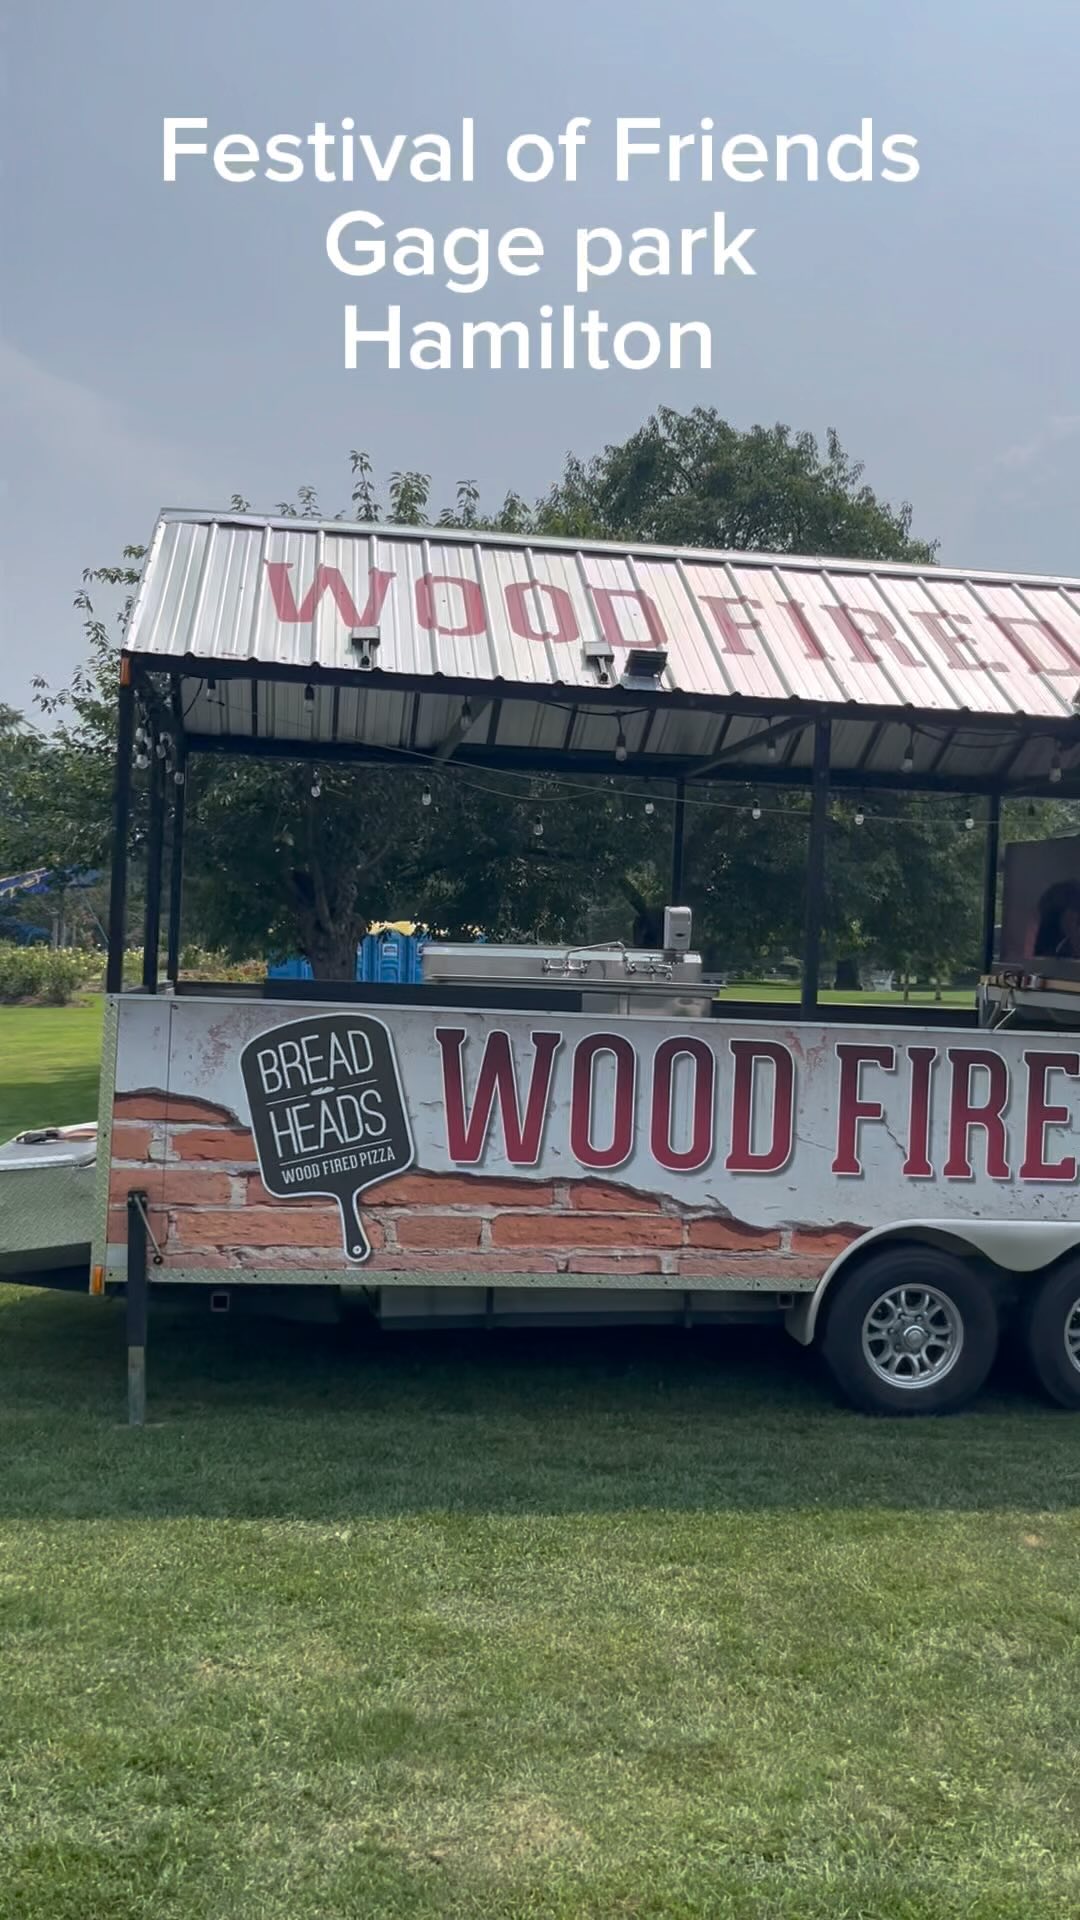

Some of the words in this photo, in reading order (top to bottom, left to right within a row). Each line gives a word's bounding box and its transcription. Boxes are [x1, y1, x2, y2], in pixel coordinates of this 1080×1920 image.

[263, 559, 668, 648] WOOD
[698, 594, 1080, 677] FIRED
[257, 1030, 374, 1094] BREAD
[269, 1089, 387, 1158] HEADS
[434, 1027, 794, 1173] WOOD
[831, 1043, 1080, 1181] FIRE
[281, 1164, 322, 1184] WOOD
[322, 1153, 359, 1176] FIRED
[360, 1146, 396, 1167] PIZZA
